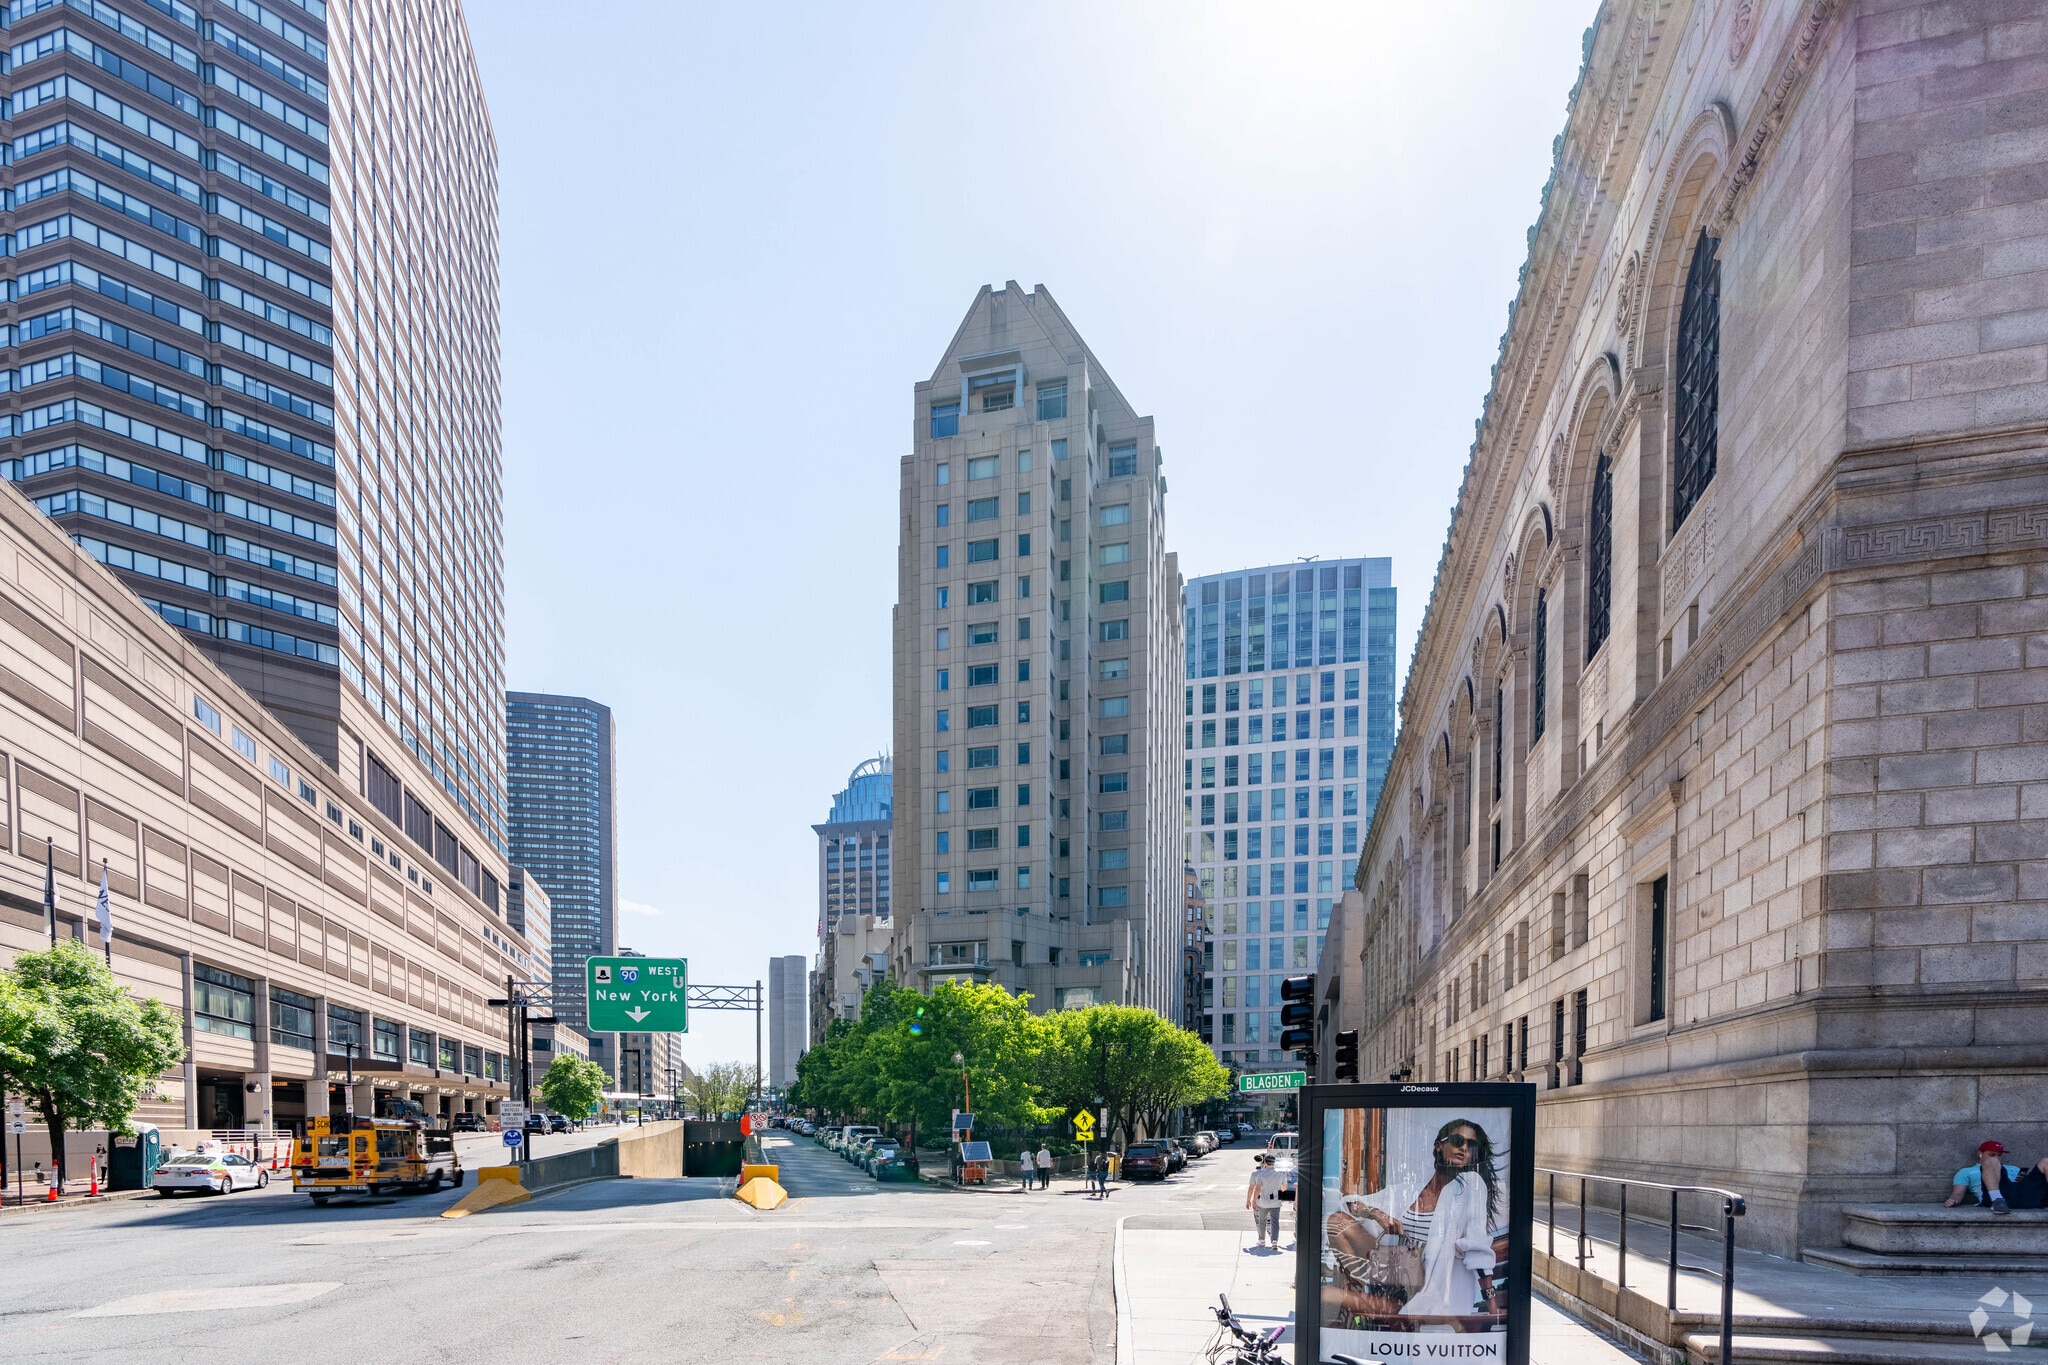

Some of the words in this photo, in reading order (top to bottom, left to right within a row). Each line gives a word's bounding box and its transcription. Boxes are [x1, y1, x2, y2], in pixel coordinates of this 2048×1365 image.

[621, 970, 637, 981] 90
[648, 966, 679, 976] WEST
[595, 989, 631, 1001] New
[640, 990, 678, 1002] York
[1246, 1074, 1291, 1090] BLAGDEN
[1294, 1079, 1300, 1087] ST
[1400, 1085, 1440, 1093] JCDecaux
[1370, 1342, 1421, 1356] LOUIS
[1426, 1343, 1497, 1357] VUITTON
